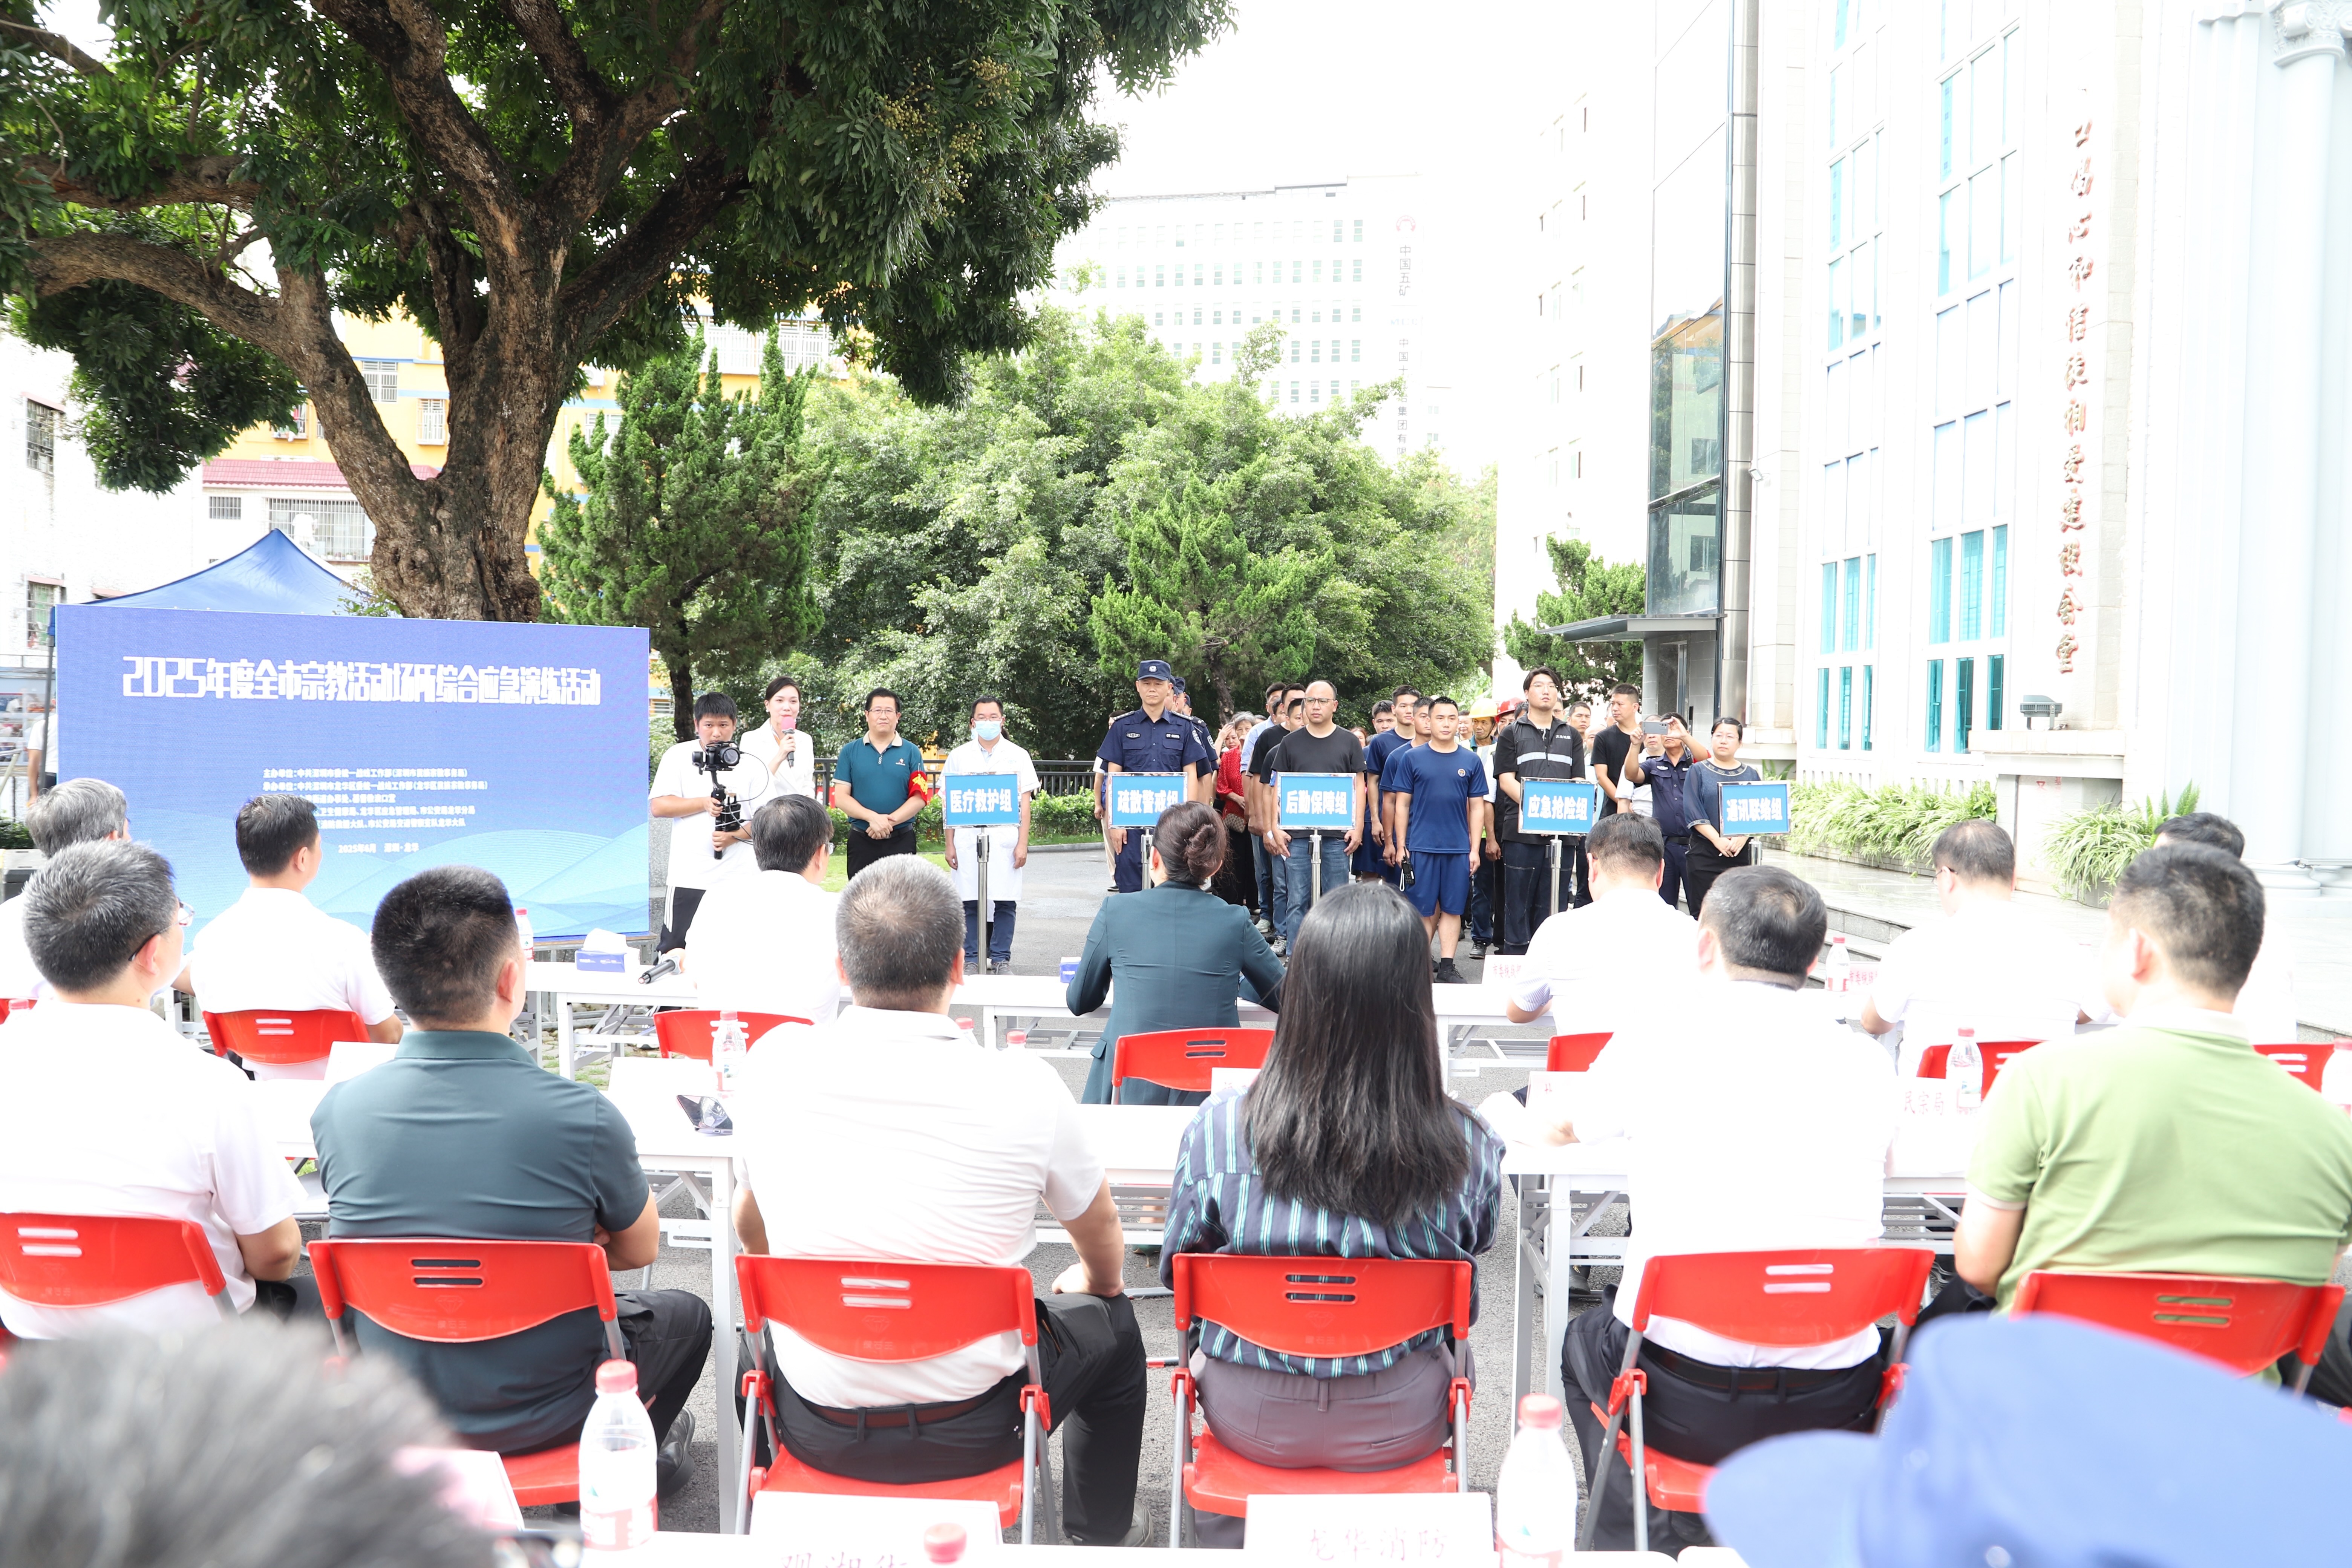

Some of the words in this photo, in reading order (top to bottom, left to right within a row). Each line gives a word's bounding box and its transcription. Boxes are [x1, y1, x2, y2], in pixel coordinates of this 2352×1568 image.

[1399, 244, 1411, 297] 中国五矿
[123, 656, 601, 705] 2025年度全市宗教活动场所综合应急演练活动
[950, 789, 1012, 813] 医疗救护组
[1117, 789, 1179, 813] 疏散警戒组
[1286, 790, 1348, 815] 后勤保障组
[1527, 794, 1588, 821] 应急抢险组
[1726, 798, 1783, 822] 通讯联络组
[338, 844, 376, 853] 2025年6月
[1308, 1527, 1448, 1561] 龙华消防
